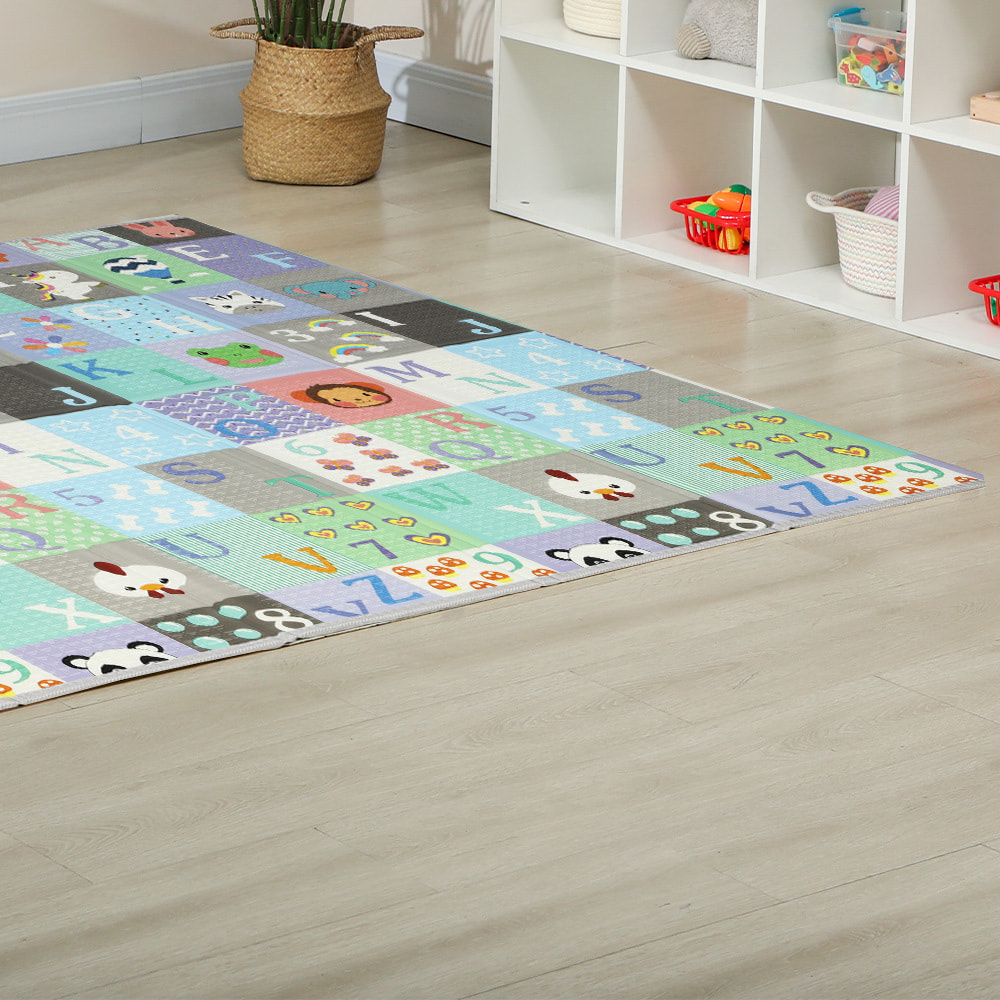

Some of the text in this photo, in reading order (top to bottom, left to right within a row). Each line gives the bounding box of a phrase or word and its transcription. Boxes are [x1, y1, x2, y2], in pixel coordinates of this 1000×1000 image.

[21, 237, 70, 251] A
[67, 235, 128, 251] B
[167, 245, 229, 262] E
[250, 251, 297, 268] F
[73, 300, 135, 320] G
[355, 311, 406, 327] I
[145, 314, 225, 335] H
[458, 318, 502, 335] J
[270, 329, 315, 343] 3
[526, 350, 570, 366] 4
[60, 358, 134, 381] K
[150, 367, 219, 386] L
[364, 359, 451, 383] M
[454, 372, 530, 394] N
[580, 383, 642, 403] S
[51, 386, 97, 406] J
[219, 391, 265, 412] P
[679, 392, 747, 416] T
[417, 410, 497, 433] R
[484, 405, 536, 423] 5
[115, 423, 159, 444] 4
[214, 418, 279, 439] O
[283, 437, 327, 456] 6
[428, 439, 512, 464] Q
[589, 444, 666, 468] U
[27, 448, 110, 474] N
[697, 456, 774, 482] V
[774, 450, 825, 471] 7
[895, 460, 946, 480] 9
[162, 461, 226, 485] S
[264, 474, 336, 498] T
[778, 480, 859, 509] Z
[52, 487, 104, 508] 5
[389, 484, 472, 513] W
[499, 499, 590, 530] X
[707, 509, 768, 532] 8
[149, 532, 230, 561] U
[347, 537, 400, 560] 7
[262, 547, 339, 575] V
[472, 551, 524, 573] 9
[341, 574, 424, 605] Z
[26, 597, 123, 630] X
[254, 608, 314, 633] 8
